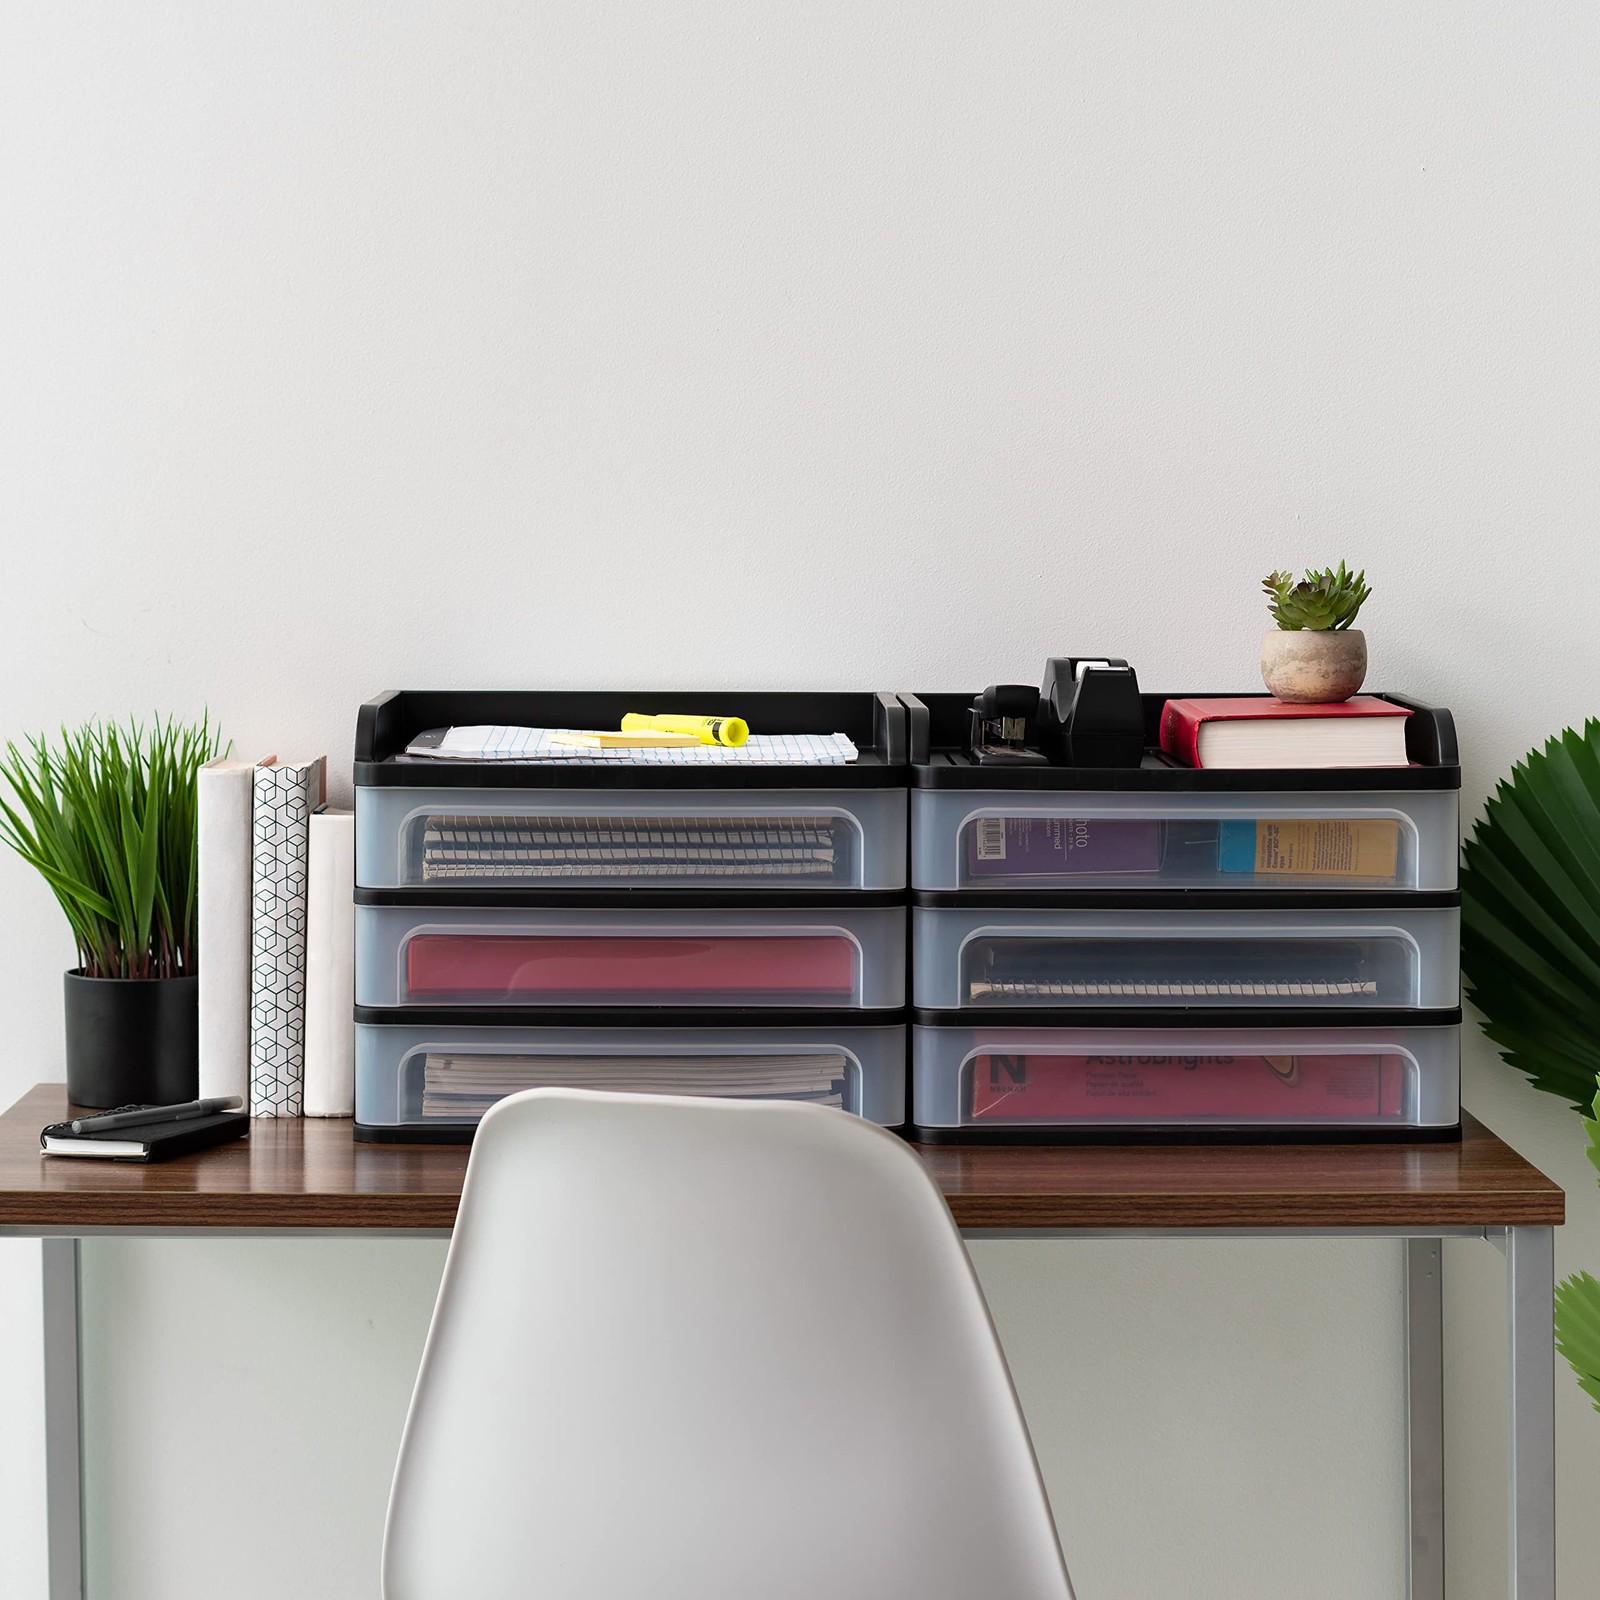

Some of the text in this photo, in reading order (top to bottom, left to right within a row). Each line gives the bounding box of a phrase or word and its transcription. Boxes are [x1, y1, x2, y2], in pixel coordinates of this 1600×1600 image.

[1053, 818, 1062, 850] ummed
[1075, 819, 1090, 848] hoto
[990, 1055, 1026, 1084] N
